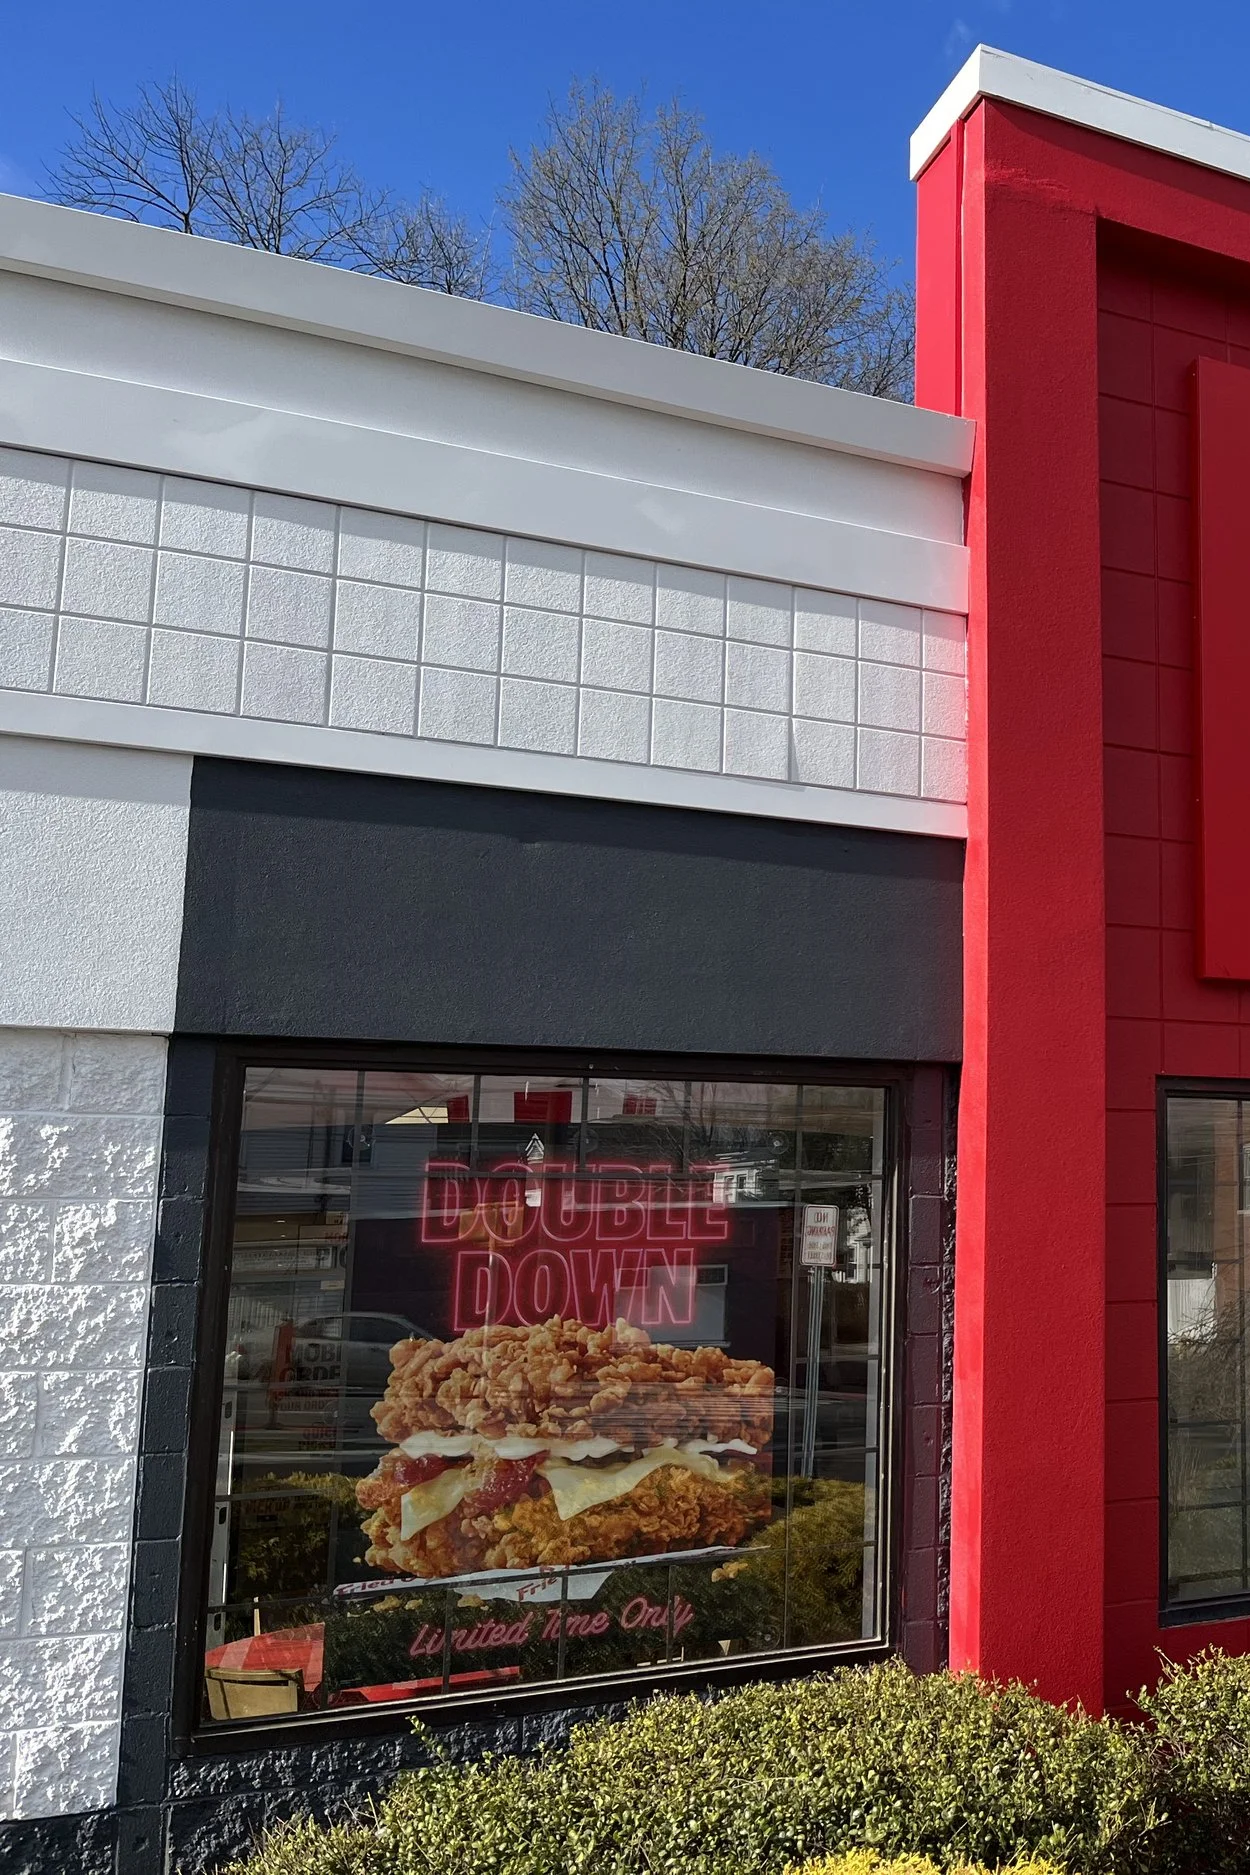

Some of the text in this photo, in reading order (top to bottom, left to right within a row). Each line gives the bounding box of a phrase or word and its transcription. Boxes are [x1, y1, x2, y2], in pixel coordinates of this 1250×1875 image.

[421, 1162, 731, 1243] DOUBLE
[454, 1247, 695, 1332] DOWN
[409, 1595, 694, 1656] Limited Time Only
